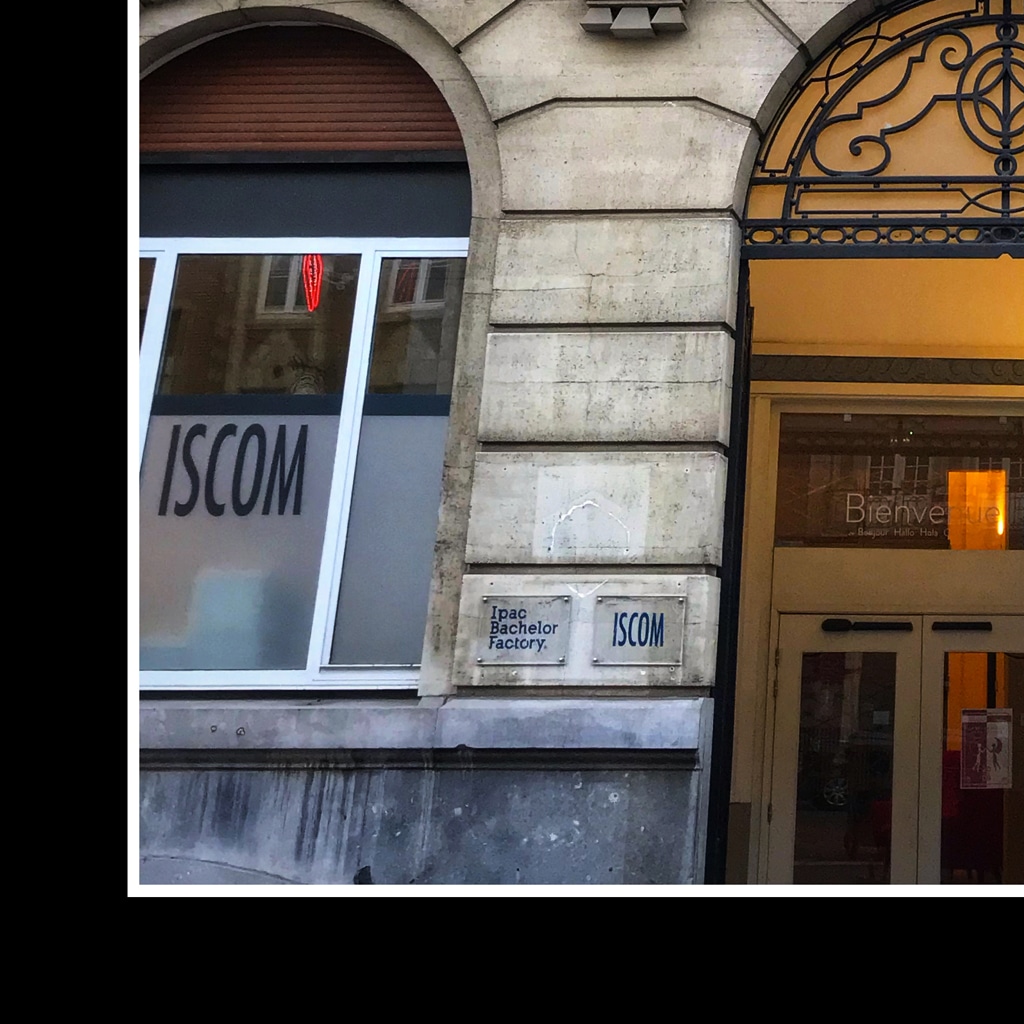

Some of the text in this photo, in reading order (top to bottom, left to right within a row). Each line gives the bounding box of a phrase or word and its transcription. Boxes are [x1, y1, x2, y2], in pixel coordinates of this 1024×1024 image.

[158, 423, 309, 517] ISCOM
[490, 606, 527, 621] Ipac
[490, 621, 558, 635] Bachelor
[612, 612, 664, 647] ISCOM
